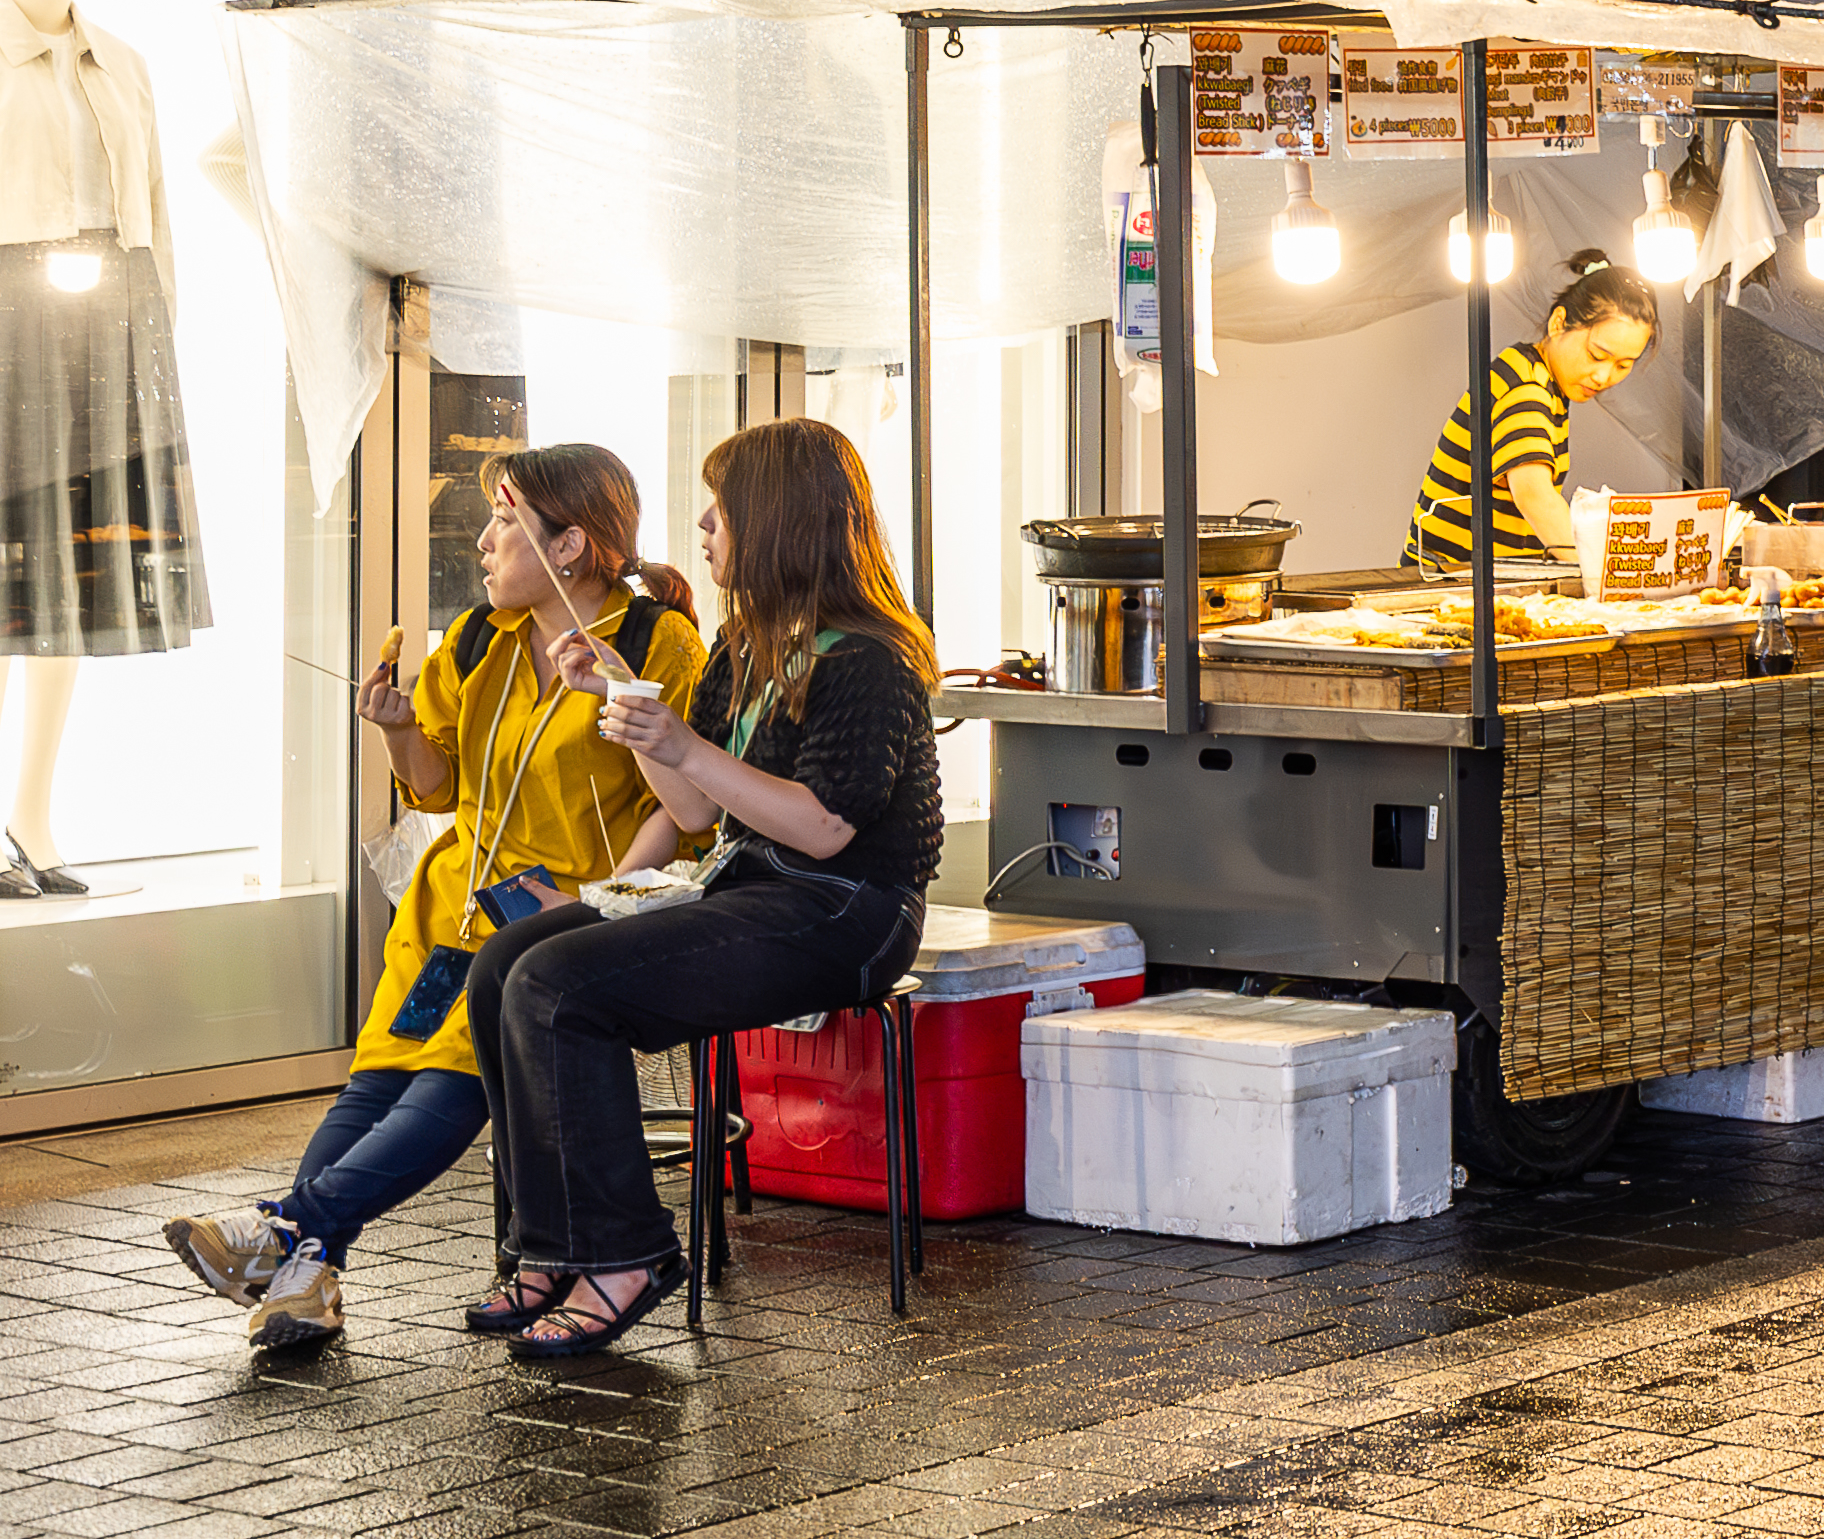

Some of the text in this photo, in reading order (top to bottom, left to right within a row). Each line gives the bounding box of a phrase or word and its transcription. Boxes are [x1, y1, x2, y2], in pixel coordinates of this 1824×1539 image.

[1195, 74, 1254, 96] kkwabaegi
[1196, 93, 1242, 112] (Twisted
[1196, 112, 1230, 130] Bread
[1610, 521, 1651, 539] 꽈배기
[1609, 538, 1668, 558] kkwabaegi
[1607, 554, 1656, 573] (Twisted
[1604, 572, 1642, 589] Bread
